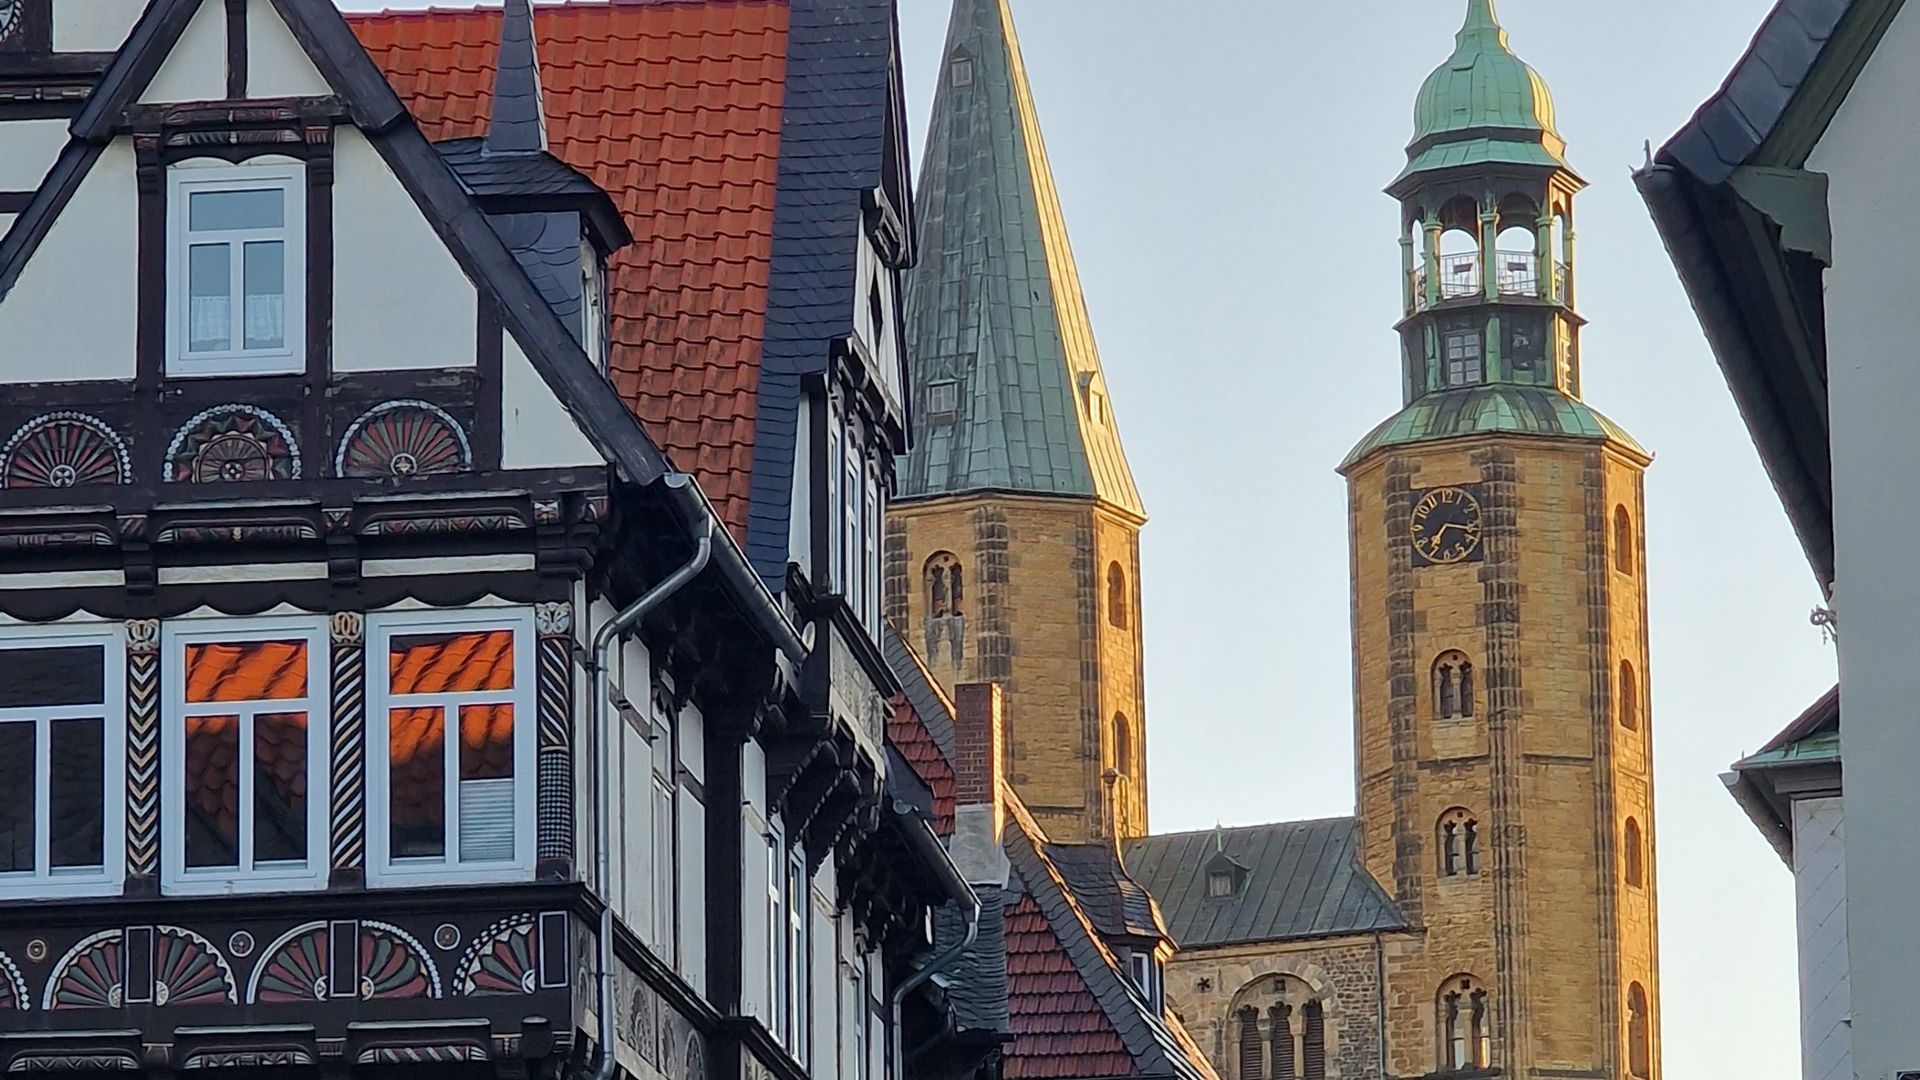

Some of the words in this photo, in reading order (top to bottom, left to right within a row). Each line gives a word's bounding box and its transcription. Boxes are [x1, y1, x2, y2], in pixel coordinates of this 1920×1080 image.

[1426, 495, 1438, 509] 11
[1442, 489, 1453, 503] 12
[1456, 492, 1464, 505] 1
[1417, 505, 1430, 519] 10
[1463, 502, 1478, 514] 2
[1410, 524, 1424, 532] 9
[1416, 537, 1428, 548] 8
[1443, 549, 1451, 560] 6
